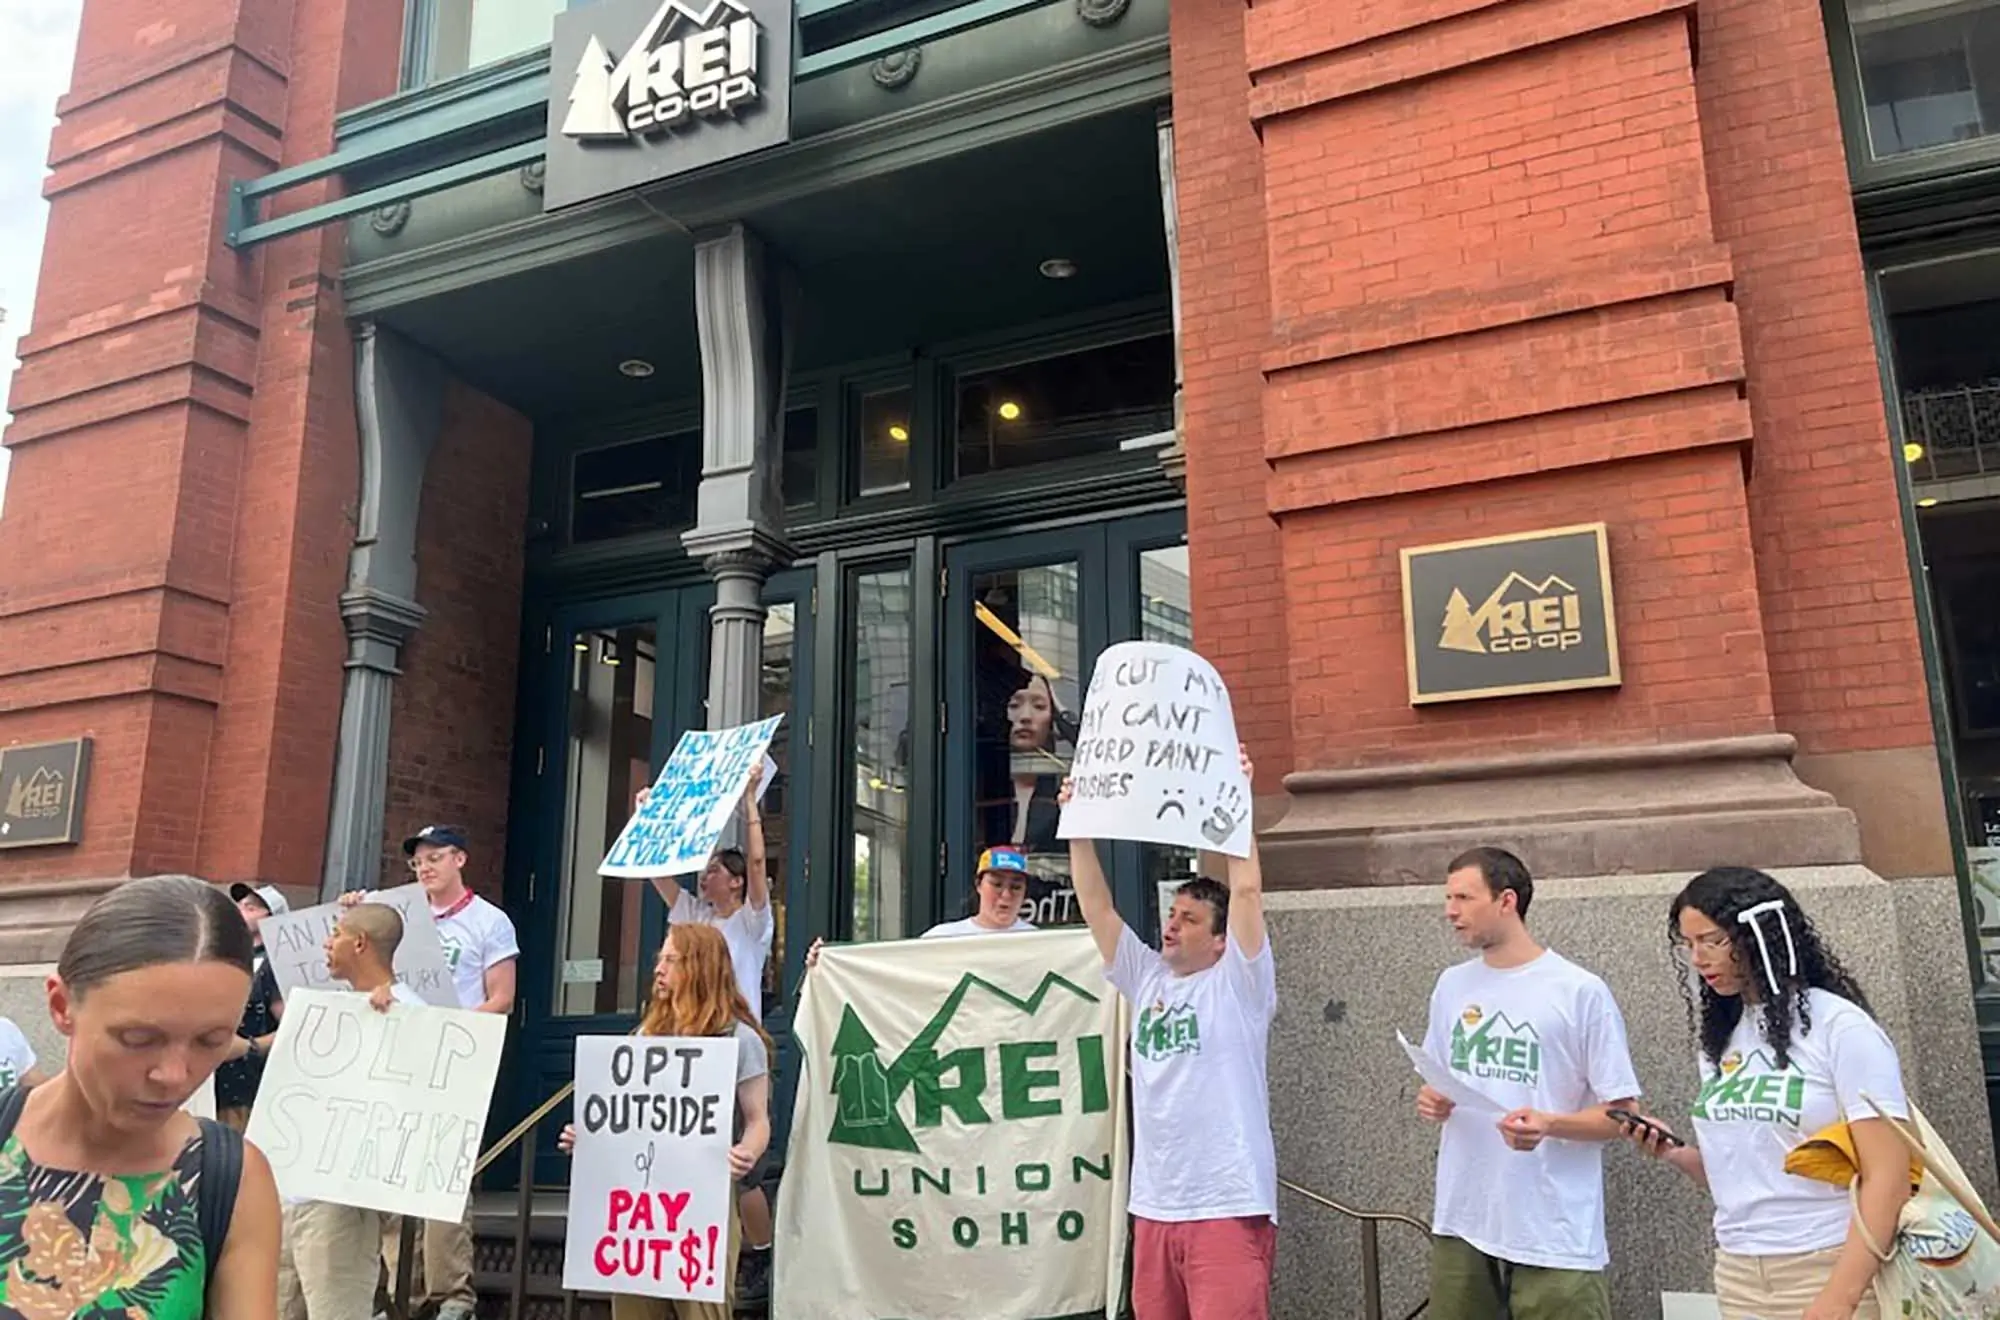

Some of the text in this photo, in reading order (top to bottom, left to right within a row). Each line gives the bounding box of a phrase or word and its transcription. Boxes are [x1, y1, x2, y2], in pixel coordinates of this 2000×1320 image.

[628, 17, 757, 107] REI
[1487, 594, 1581, 639] REI
[1116, 658, 1169, 688] CUT
[1122, 702, 1212, 735] CANT
[1076, 736, 1224, 775] FFORD PAINT
[25, 782, 64, 809] REI
[607, 838, 675, 867] LIVING
[274, 918, 315, 961] AN
[294, 1003, 478, 1090] ULP
[611, 1045, 703, 1088] OPT
[1476, 1036, 1541, 1072] REI
[913, 1035, 1110, 1128] REI
[1475, 1065, 1539, 1087] UNION
[1716, 1074, 1806, 1111] REI
[583, 1093, 720, 1137] OUTSIDE
[1713, 1106, 1801, 1128] UNION
[268, 1083, 480, 1195] STRIKE
[854, 1154, 1112, 1197] UNION
[608, 1189, 692, 1233] PAY
[892, 1210, 1084, 1249] SOHO
[594, 1225, 720, 1293] CUT$!
